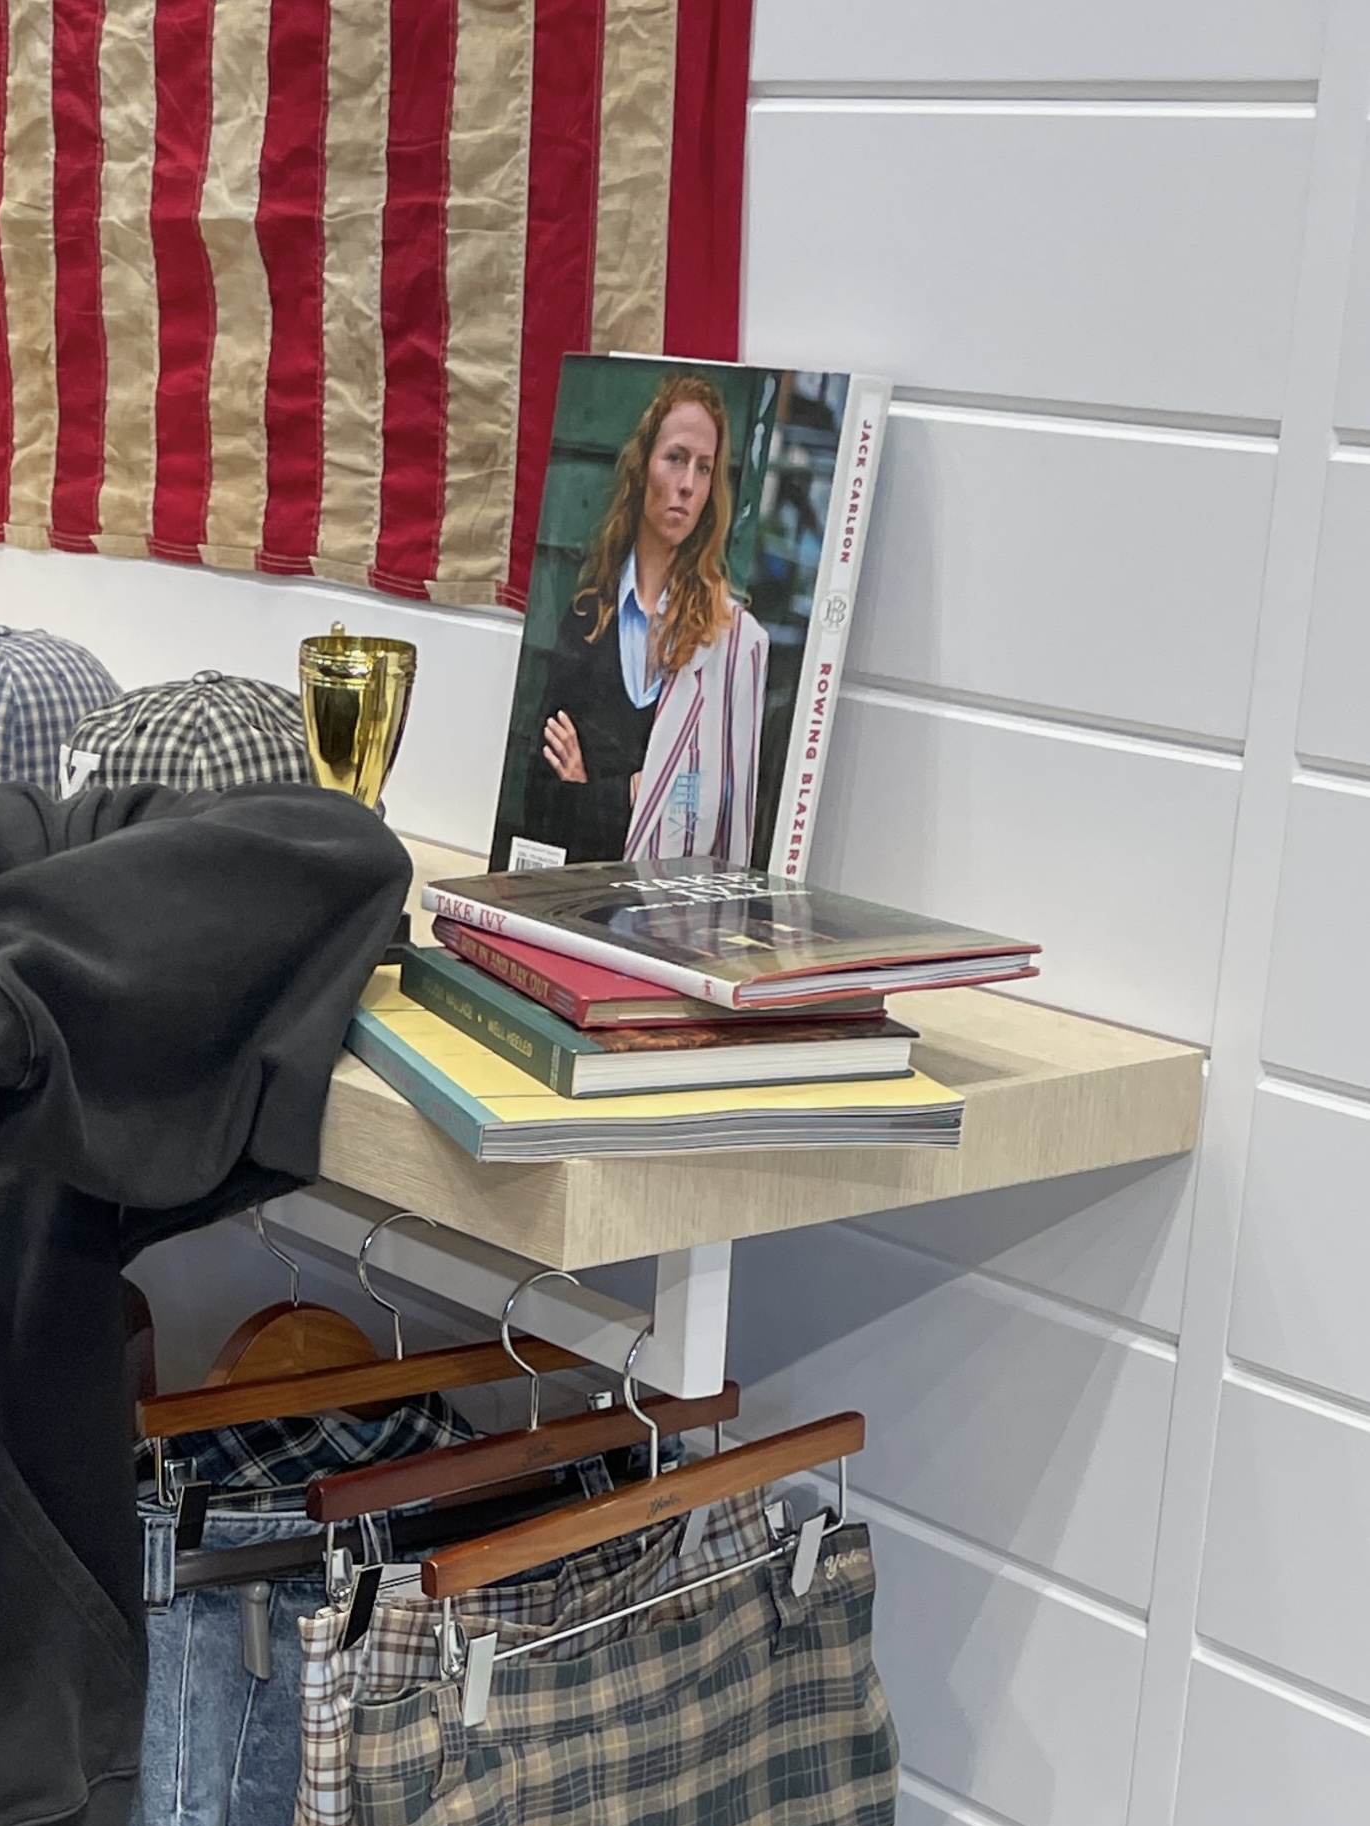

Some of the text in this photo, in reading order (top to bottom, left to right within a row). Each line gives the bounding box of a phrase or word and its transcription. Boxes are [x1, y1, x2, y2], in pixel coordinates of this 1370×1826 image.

[856, 419, 872, 468] JACK
[785, 662, 833, 876] ROWING BLAZERS
[436, 895, 474, 921] TAKE
[479, 907, 508, 932] IVY
[530, 975, 549, 998] OUT
